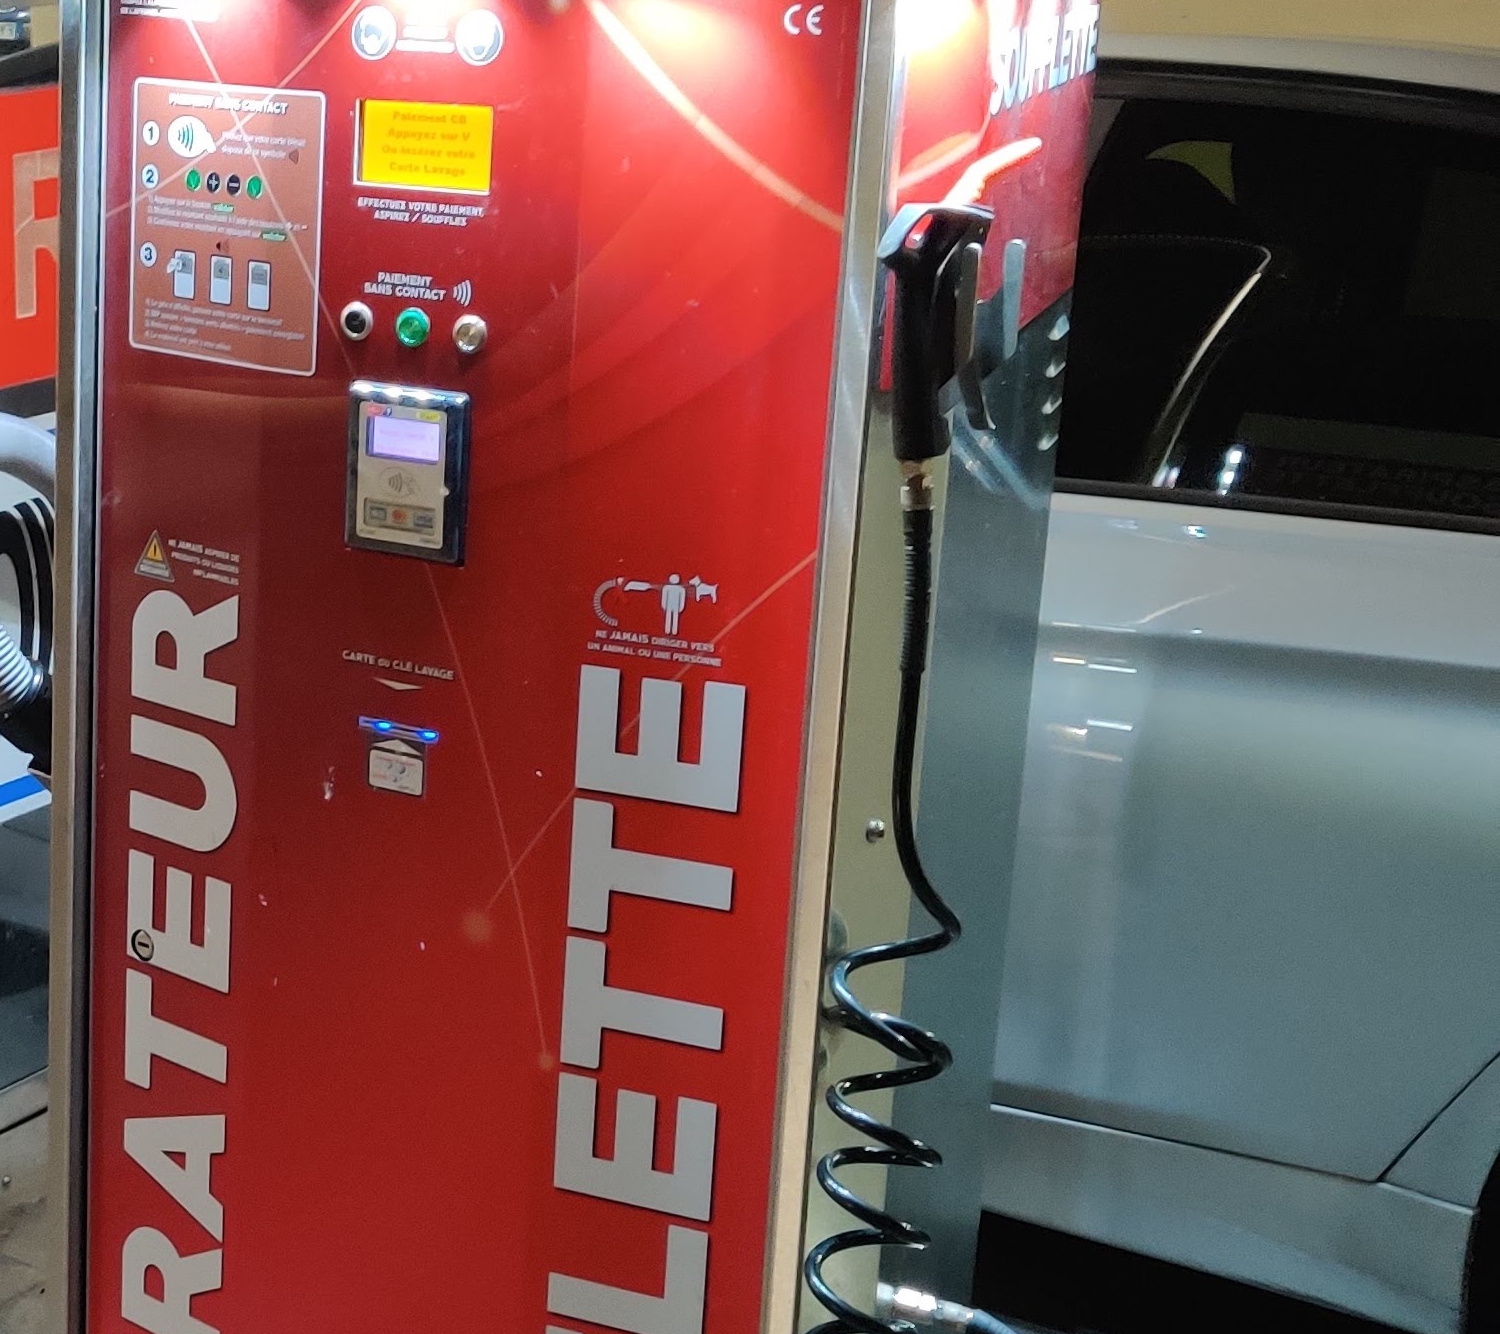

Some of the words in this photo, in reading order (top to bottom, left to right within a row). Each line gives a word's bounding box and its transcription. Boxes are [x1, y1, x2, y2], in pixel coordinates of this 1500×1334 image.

[784, 3, 825, 36] CE
[377, 271, 433, 287] PAIEMENT
[363, 282, 392, 296] SANS
[395, 285, 447, 301] CONTACT
[587, 641, 600, 651] UN
[602, 643, 636, 656] ANIMAL
[609, 631, 649, 644] JAMAIS
[651, 636, 688, 649] DIRIGER
[691, 641, 716, 653] VERS
[342, 649, 375, 665] CARTE
[415, 664, 455, 681] LAVAGE
